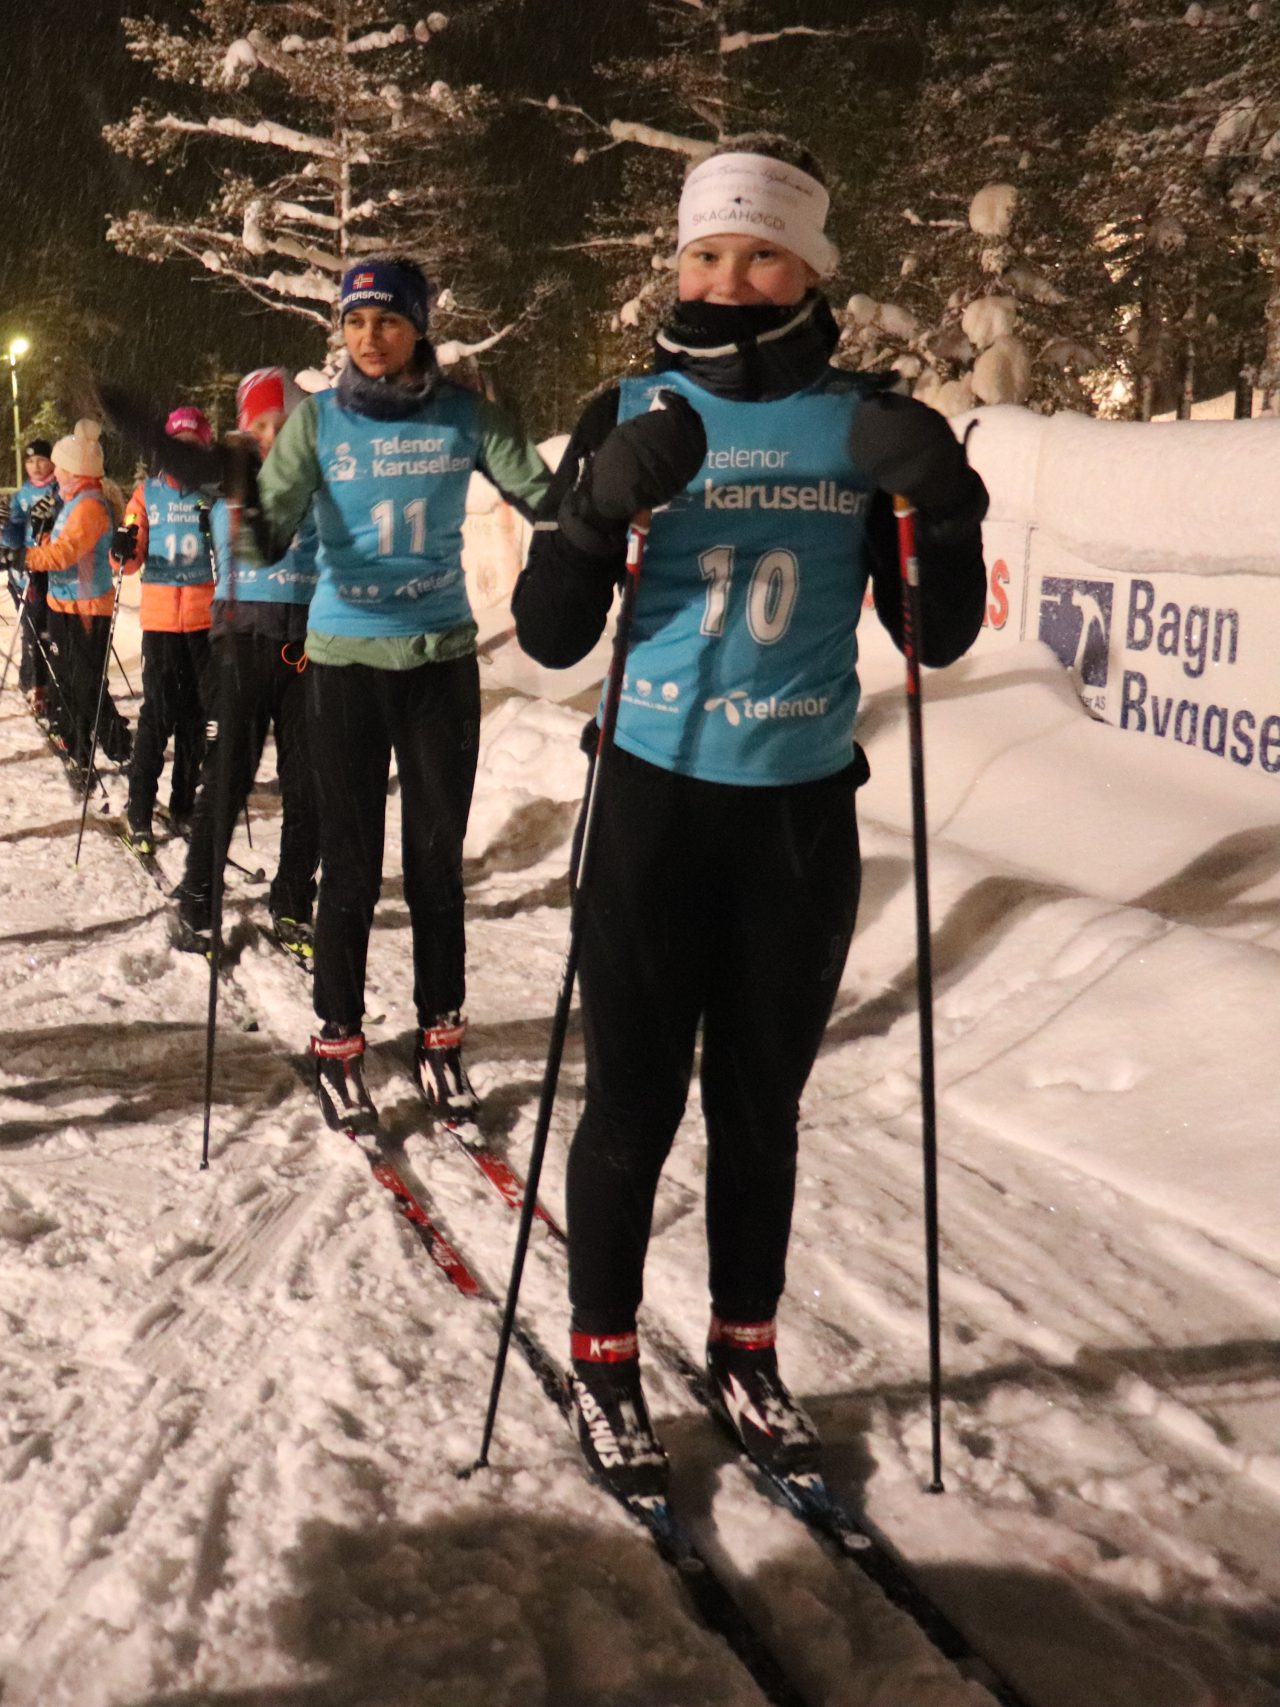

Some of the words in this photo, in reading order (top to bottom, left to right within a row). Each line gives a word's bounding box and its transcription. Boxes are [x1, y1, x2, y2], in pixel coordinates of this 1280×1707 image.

[371, 435, 445, 455] Telenor
[707, 446, 790, 469] telenor
[370, 497, 427, 556] 11
[164, 533, 198, 566] 19
[698, 544, 800, 646] 10
[1126, 579, 1239, 678] Bagn
[743, 697, 828, 720] telenor
